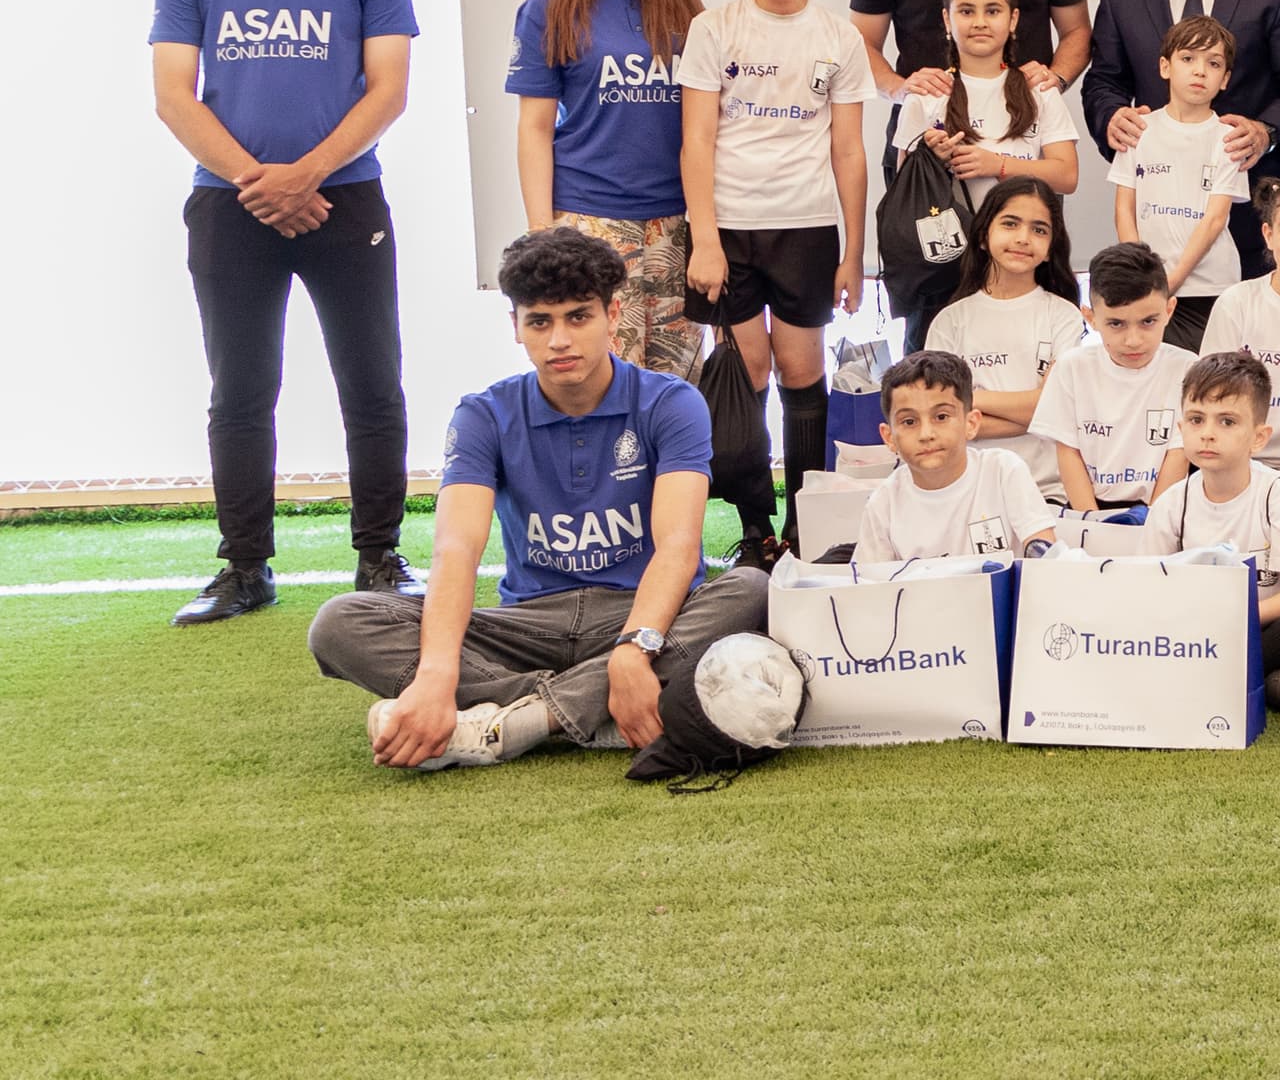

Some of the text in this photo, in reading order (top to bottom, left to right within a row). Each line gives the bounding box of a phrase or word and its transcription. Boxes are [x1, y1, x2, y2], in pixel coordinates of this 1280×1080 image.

[216, 8, 332, 45] ASAN
[216, 40, 329, 62] KÖNÜLLÜLƏRİ
[741, 65, 779, 78] YAŞAT
[599, 86, 682, 106] KÖNÜLLÜLƏ
[1151, 204, 1205, 220] TuranBan
[970, 353, 1009, 369] YAŞAT
[1083, 422, 1114, 438] YAAT
[527, 502, 644, 552] ASAN
[1080, 631, 1219, 660] TuranBank
[817, 646, 967, 677] TuranBank
